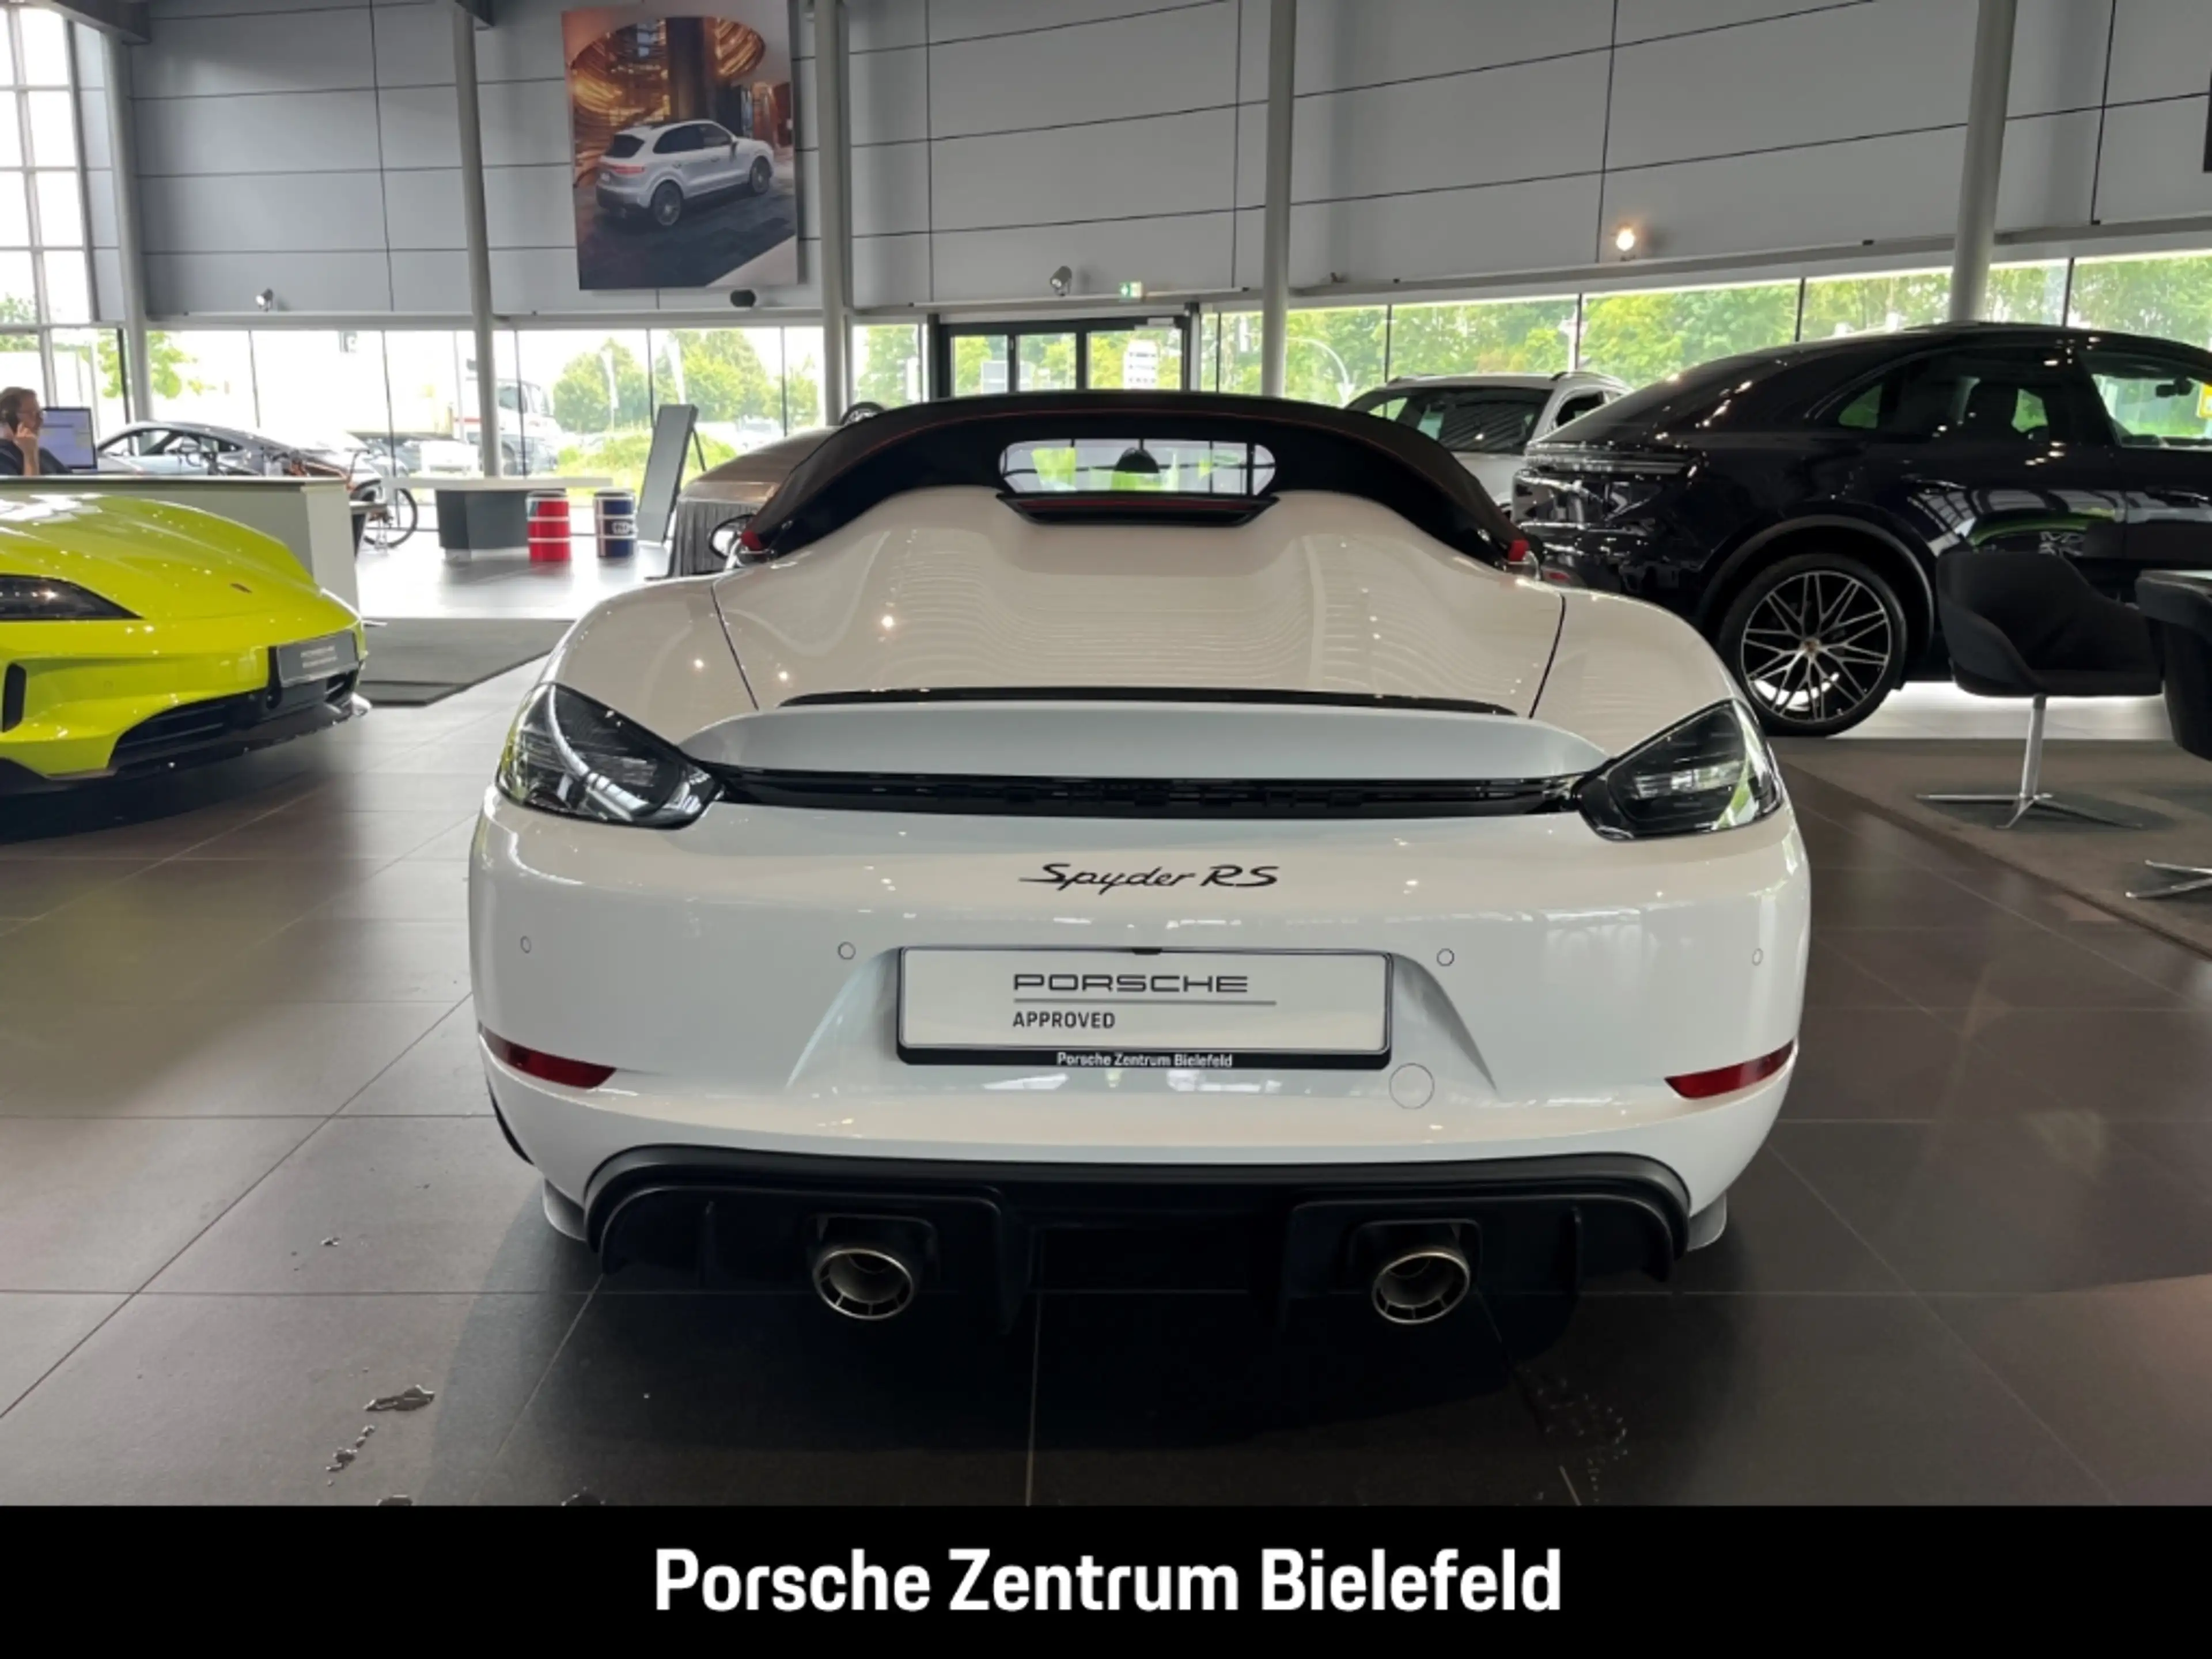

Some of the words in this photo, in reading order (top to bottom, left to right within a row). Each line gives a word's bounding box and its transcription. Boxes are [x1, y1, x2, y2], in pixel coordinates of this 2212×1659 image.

[1020, 863, 1196, 895] Spyder
[1200, 864, 1279, 888] RS
[1013, 973, 1248, 993] PORSCHE
[1013, 1010, 1116, 1029] APPROVED
[1056, 1051, 1112, 1066] Porsche
[1114, 1053, 1171, 1066] Zentrum
[1174, 1054, 1233, 1067] Bielefeld
